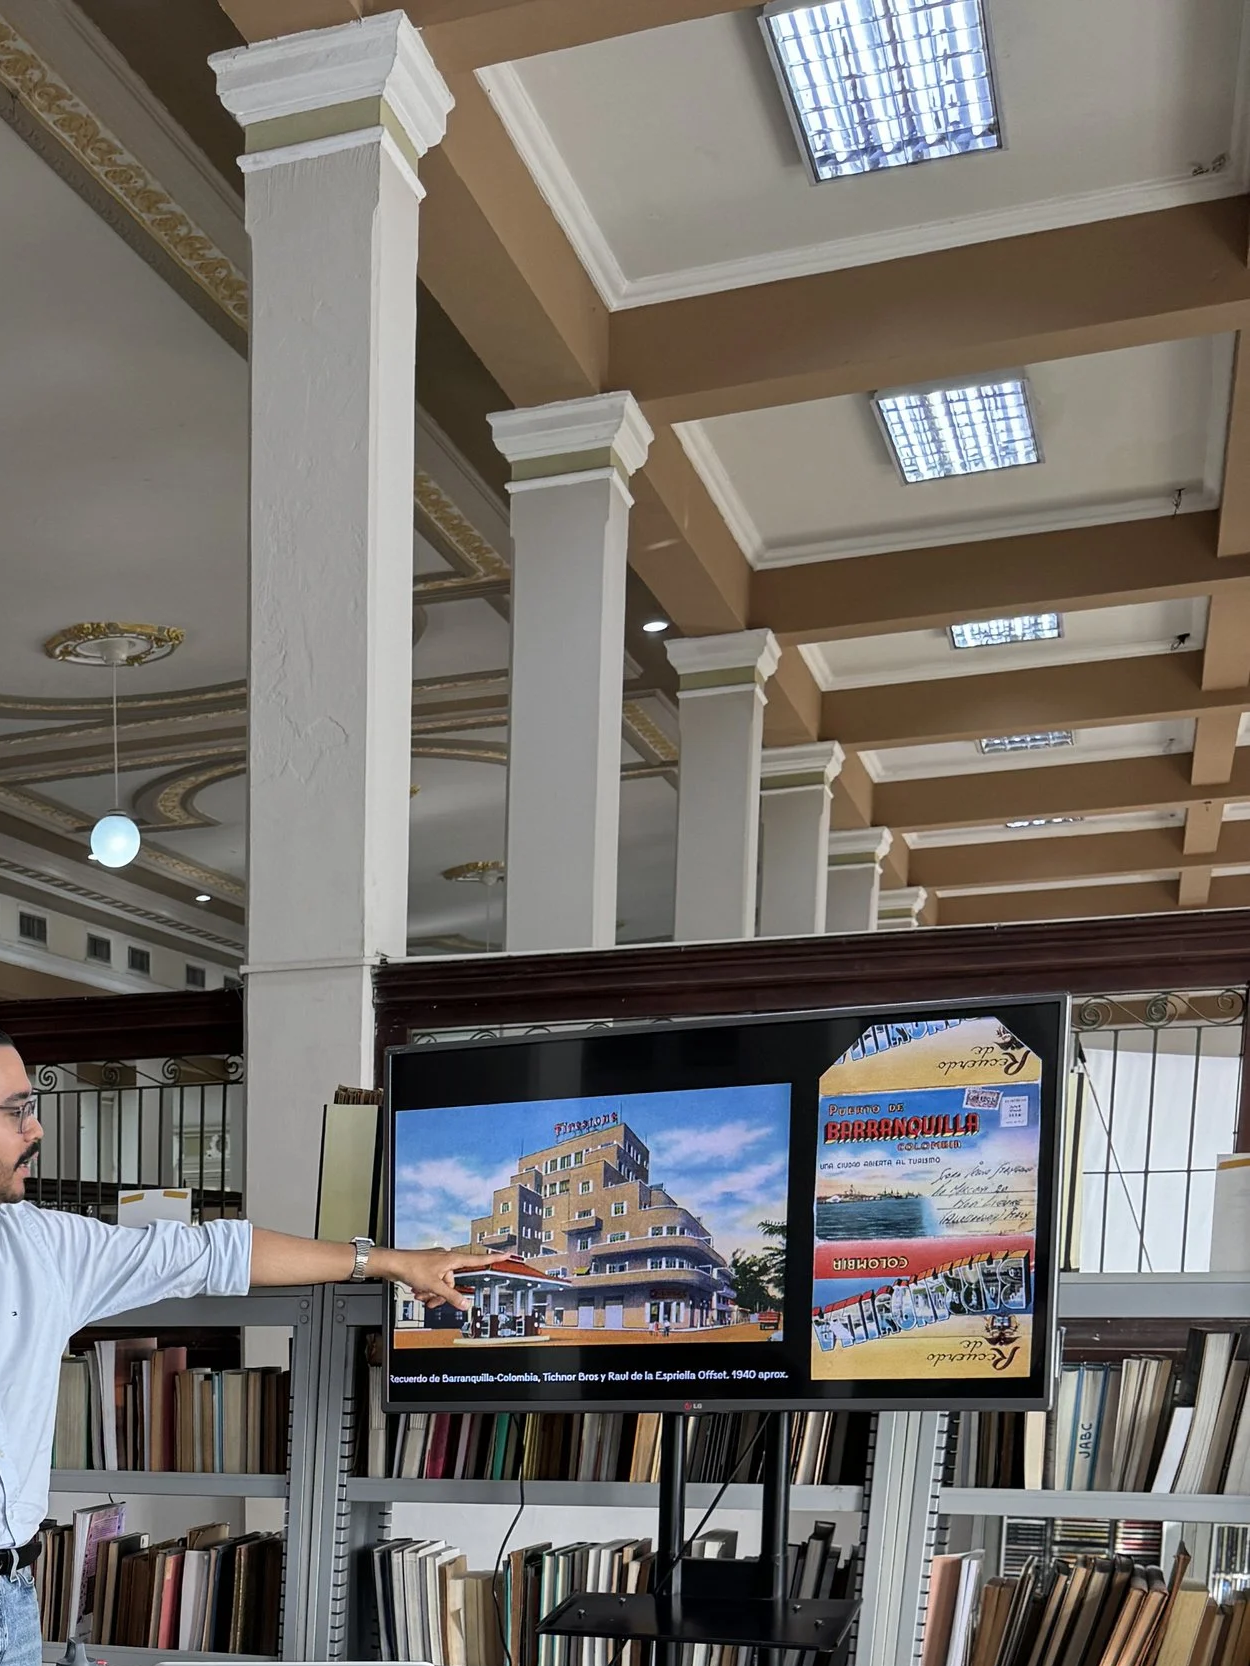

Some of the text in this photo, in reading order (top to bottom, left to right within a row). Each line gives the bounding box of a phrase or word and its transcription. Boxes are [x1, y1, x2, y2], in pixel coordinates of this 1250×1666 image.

[972, 1046, 995, 1055] de
[938, 1050, 1030, 1076] Recuerdo
[824, 1112, 980, 1144] BARRANQUILLA
[897, 1140, 962, 1151] COLOMBIA
[863, 1159, 892, 1167] ABIERTA
[833, 1256, 909, 1271] COLOMBIA
[812, 1250, 1031, 1352] BARRANQUILLA
[960, 1340, 982, 1350] de
[927, 1346, 1020, 1370] Recuerdo
[429, 1373, 440, 1383] de
[442, 1372, 541, 1384] Barranquilla-Colombia,
[542, 1372, 576, 1382] Tichnor
[578, 1372, 599, 1381] Bros
[600, 1373, 606, 1383] y
[631, 1371, 643, 1381] de
[645, 1371, 654, 1380] la
[656, 1370, 696, 1382] Espriella
[732, 1370, 756, 1379] 1940
[758, 1371, 789, 1381] aprox.
